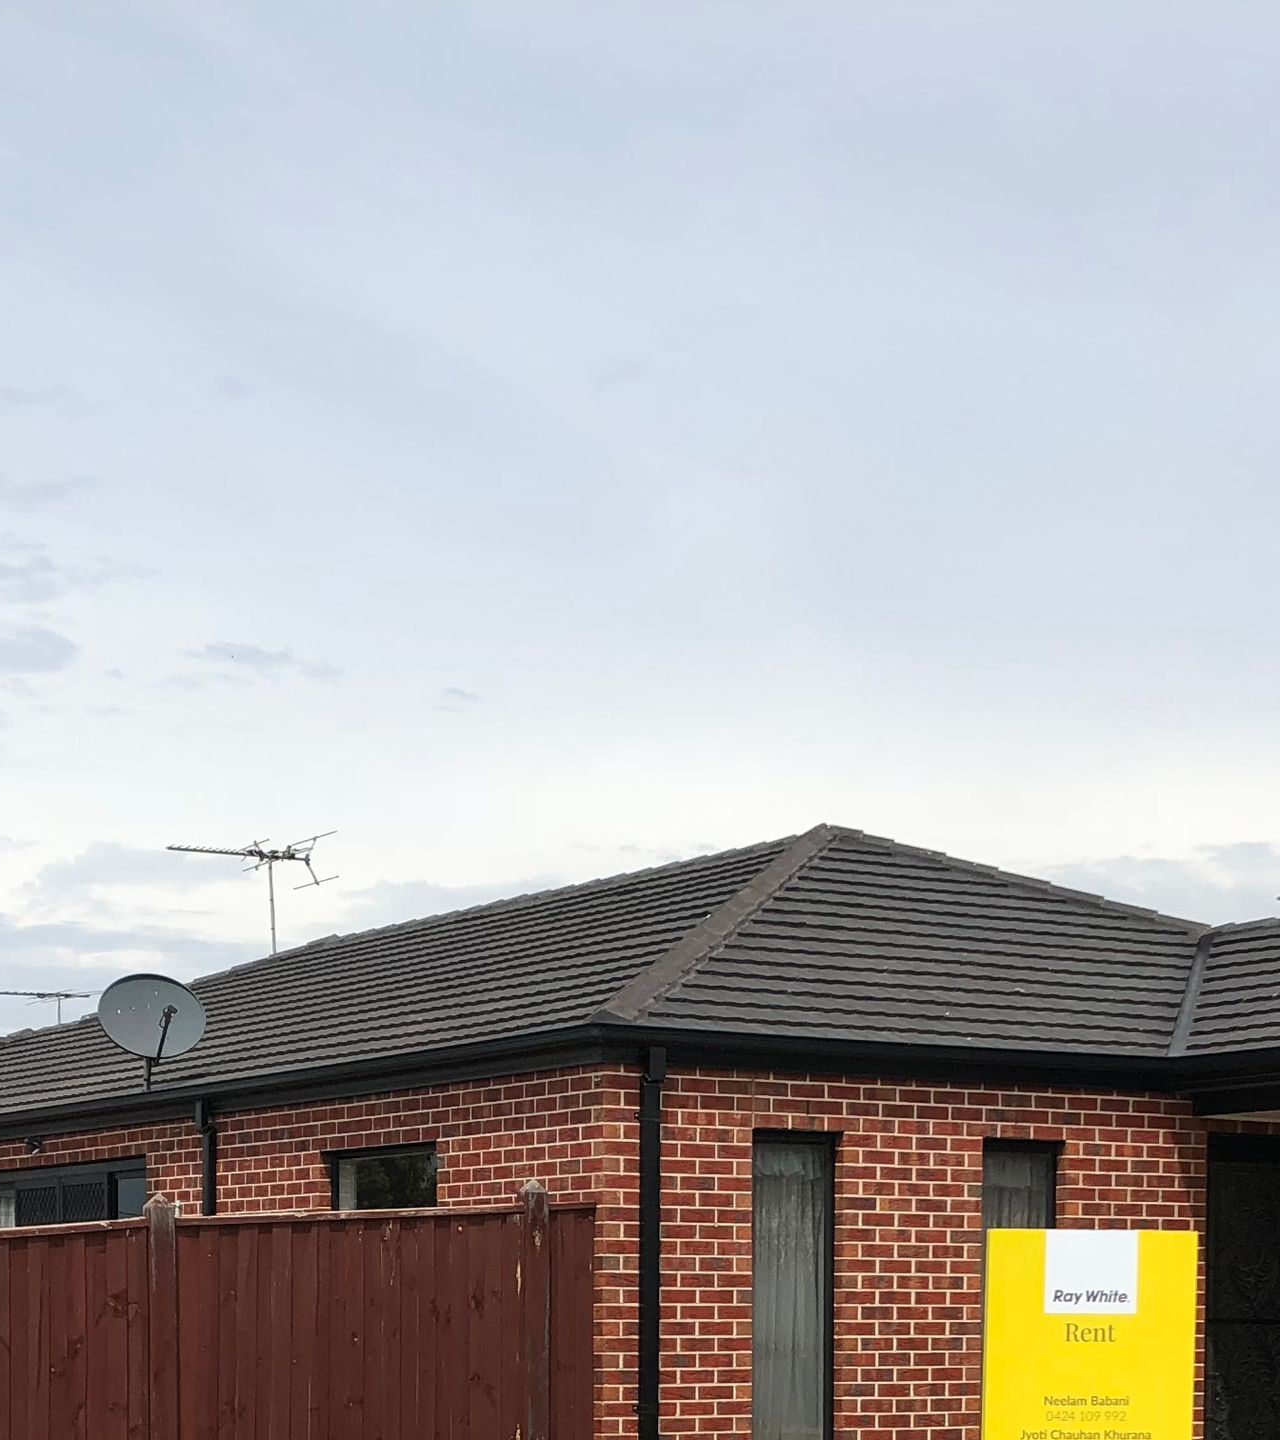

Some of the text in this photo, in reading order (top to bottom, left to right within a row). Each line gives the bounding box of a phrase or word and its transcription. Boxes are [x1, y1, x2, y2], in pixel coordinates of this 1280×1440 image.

[1052, 1289, 1083, 1305] Ray
[1064, 1322, 1117, 1343] Rent
[1043, 1395, 1130, 1406] Neelam Babani
[1045, 1410, 1127, 1422] 0424 109 992
[1050, 1429, 1101, 1440] Chauhan
[1104, 1429, 1152, 1440] Khurana
